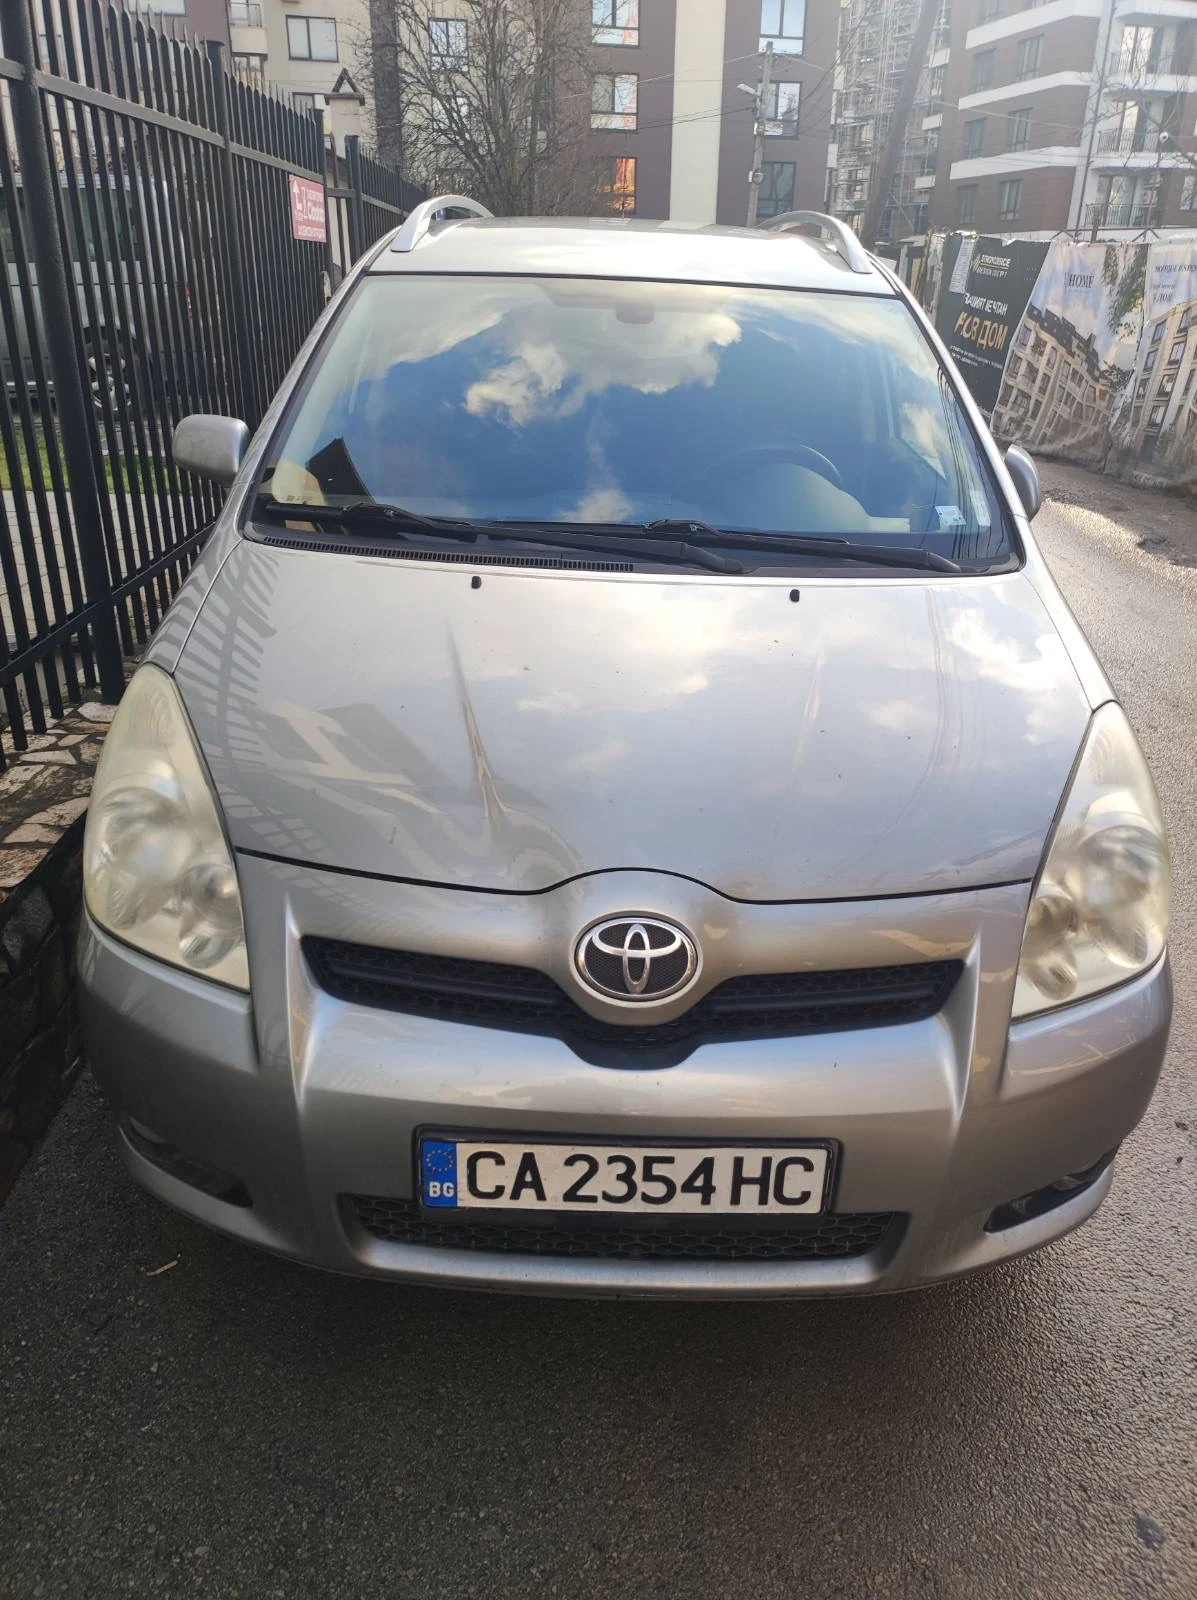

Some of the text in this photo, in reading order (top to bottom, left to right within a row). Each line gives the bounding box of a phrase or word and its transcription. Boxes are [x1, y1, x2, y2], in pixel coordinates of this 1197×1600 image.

[977, 320, 1008, 350] ДОМ
[428, 1181, 455, 1198] BG
[466, 1151, 815, 1206] CA 2354 HC
